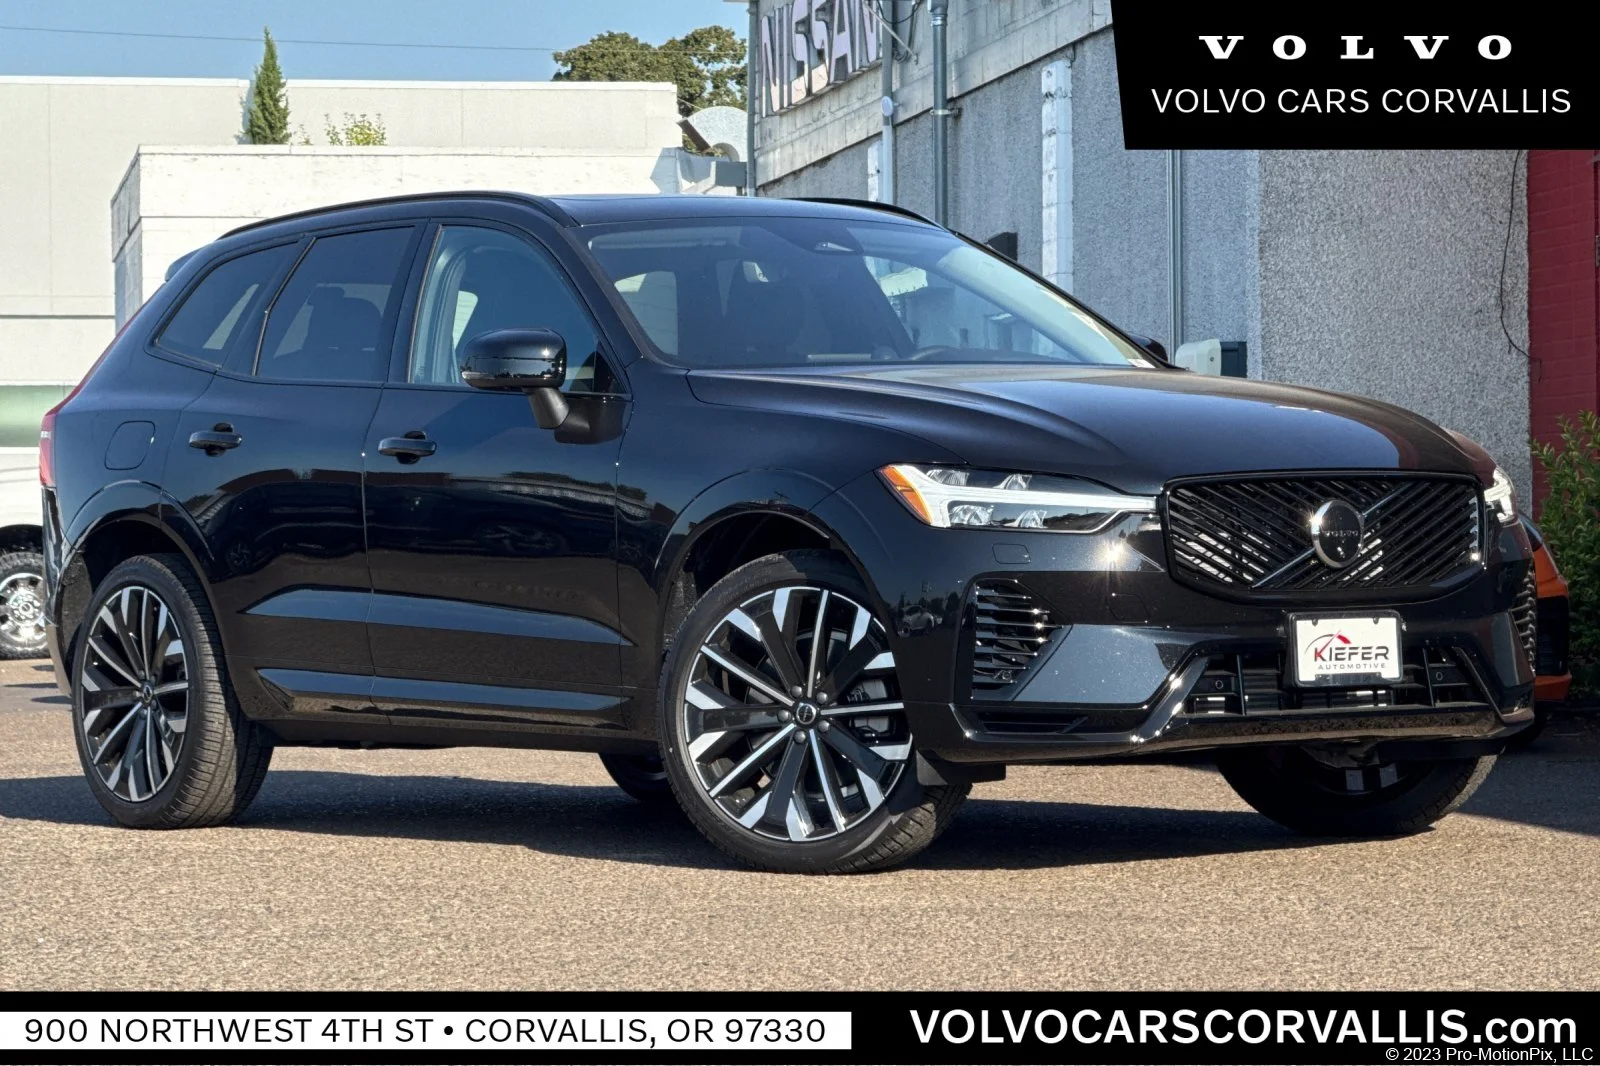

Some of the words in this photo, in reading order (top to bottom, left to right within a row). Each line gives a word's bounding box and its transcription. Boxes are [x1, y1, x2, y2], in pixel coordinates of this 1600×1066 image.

[761, 0, 877, 118] NISSAN
[1314, 646, 1389, 662] KIEFER
[1318, 662, 1386, 670] AUTOMOTIVE
